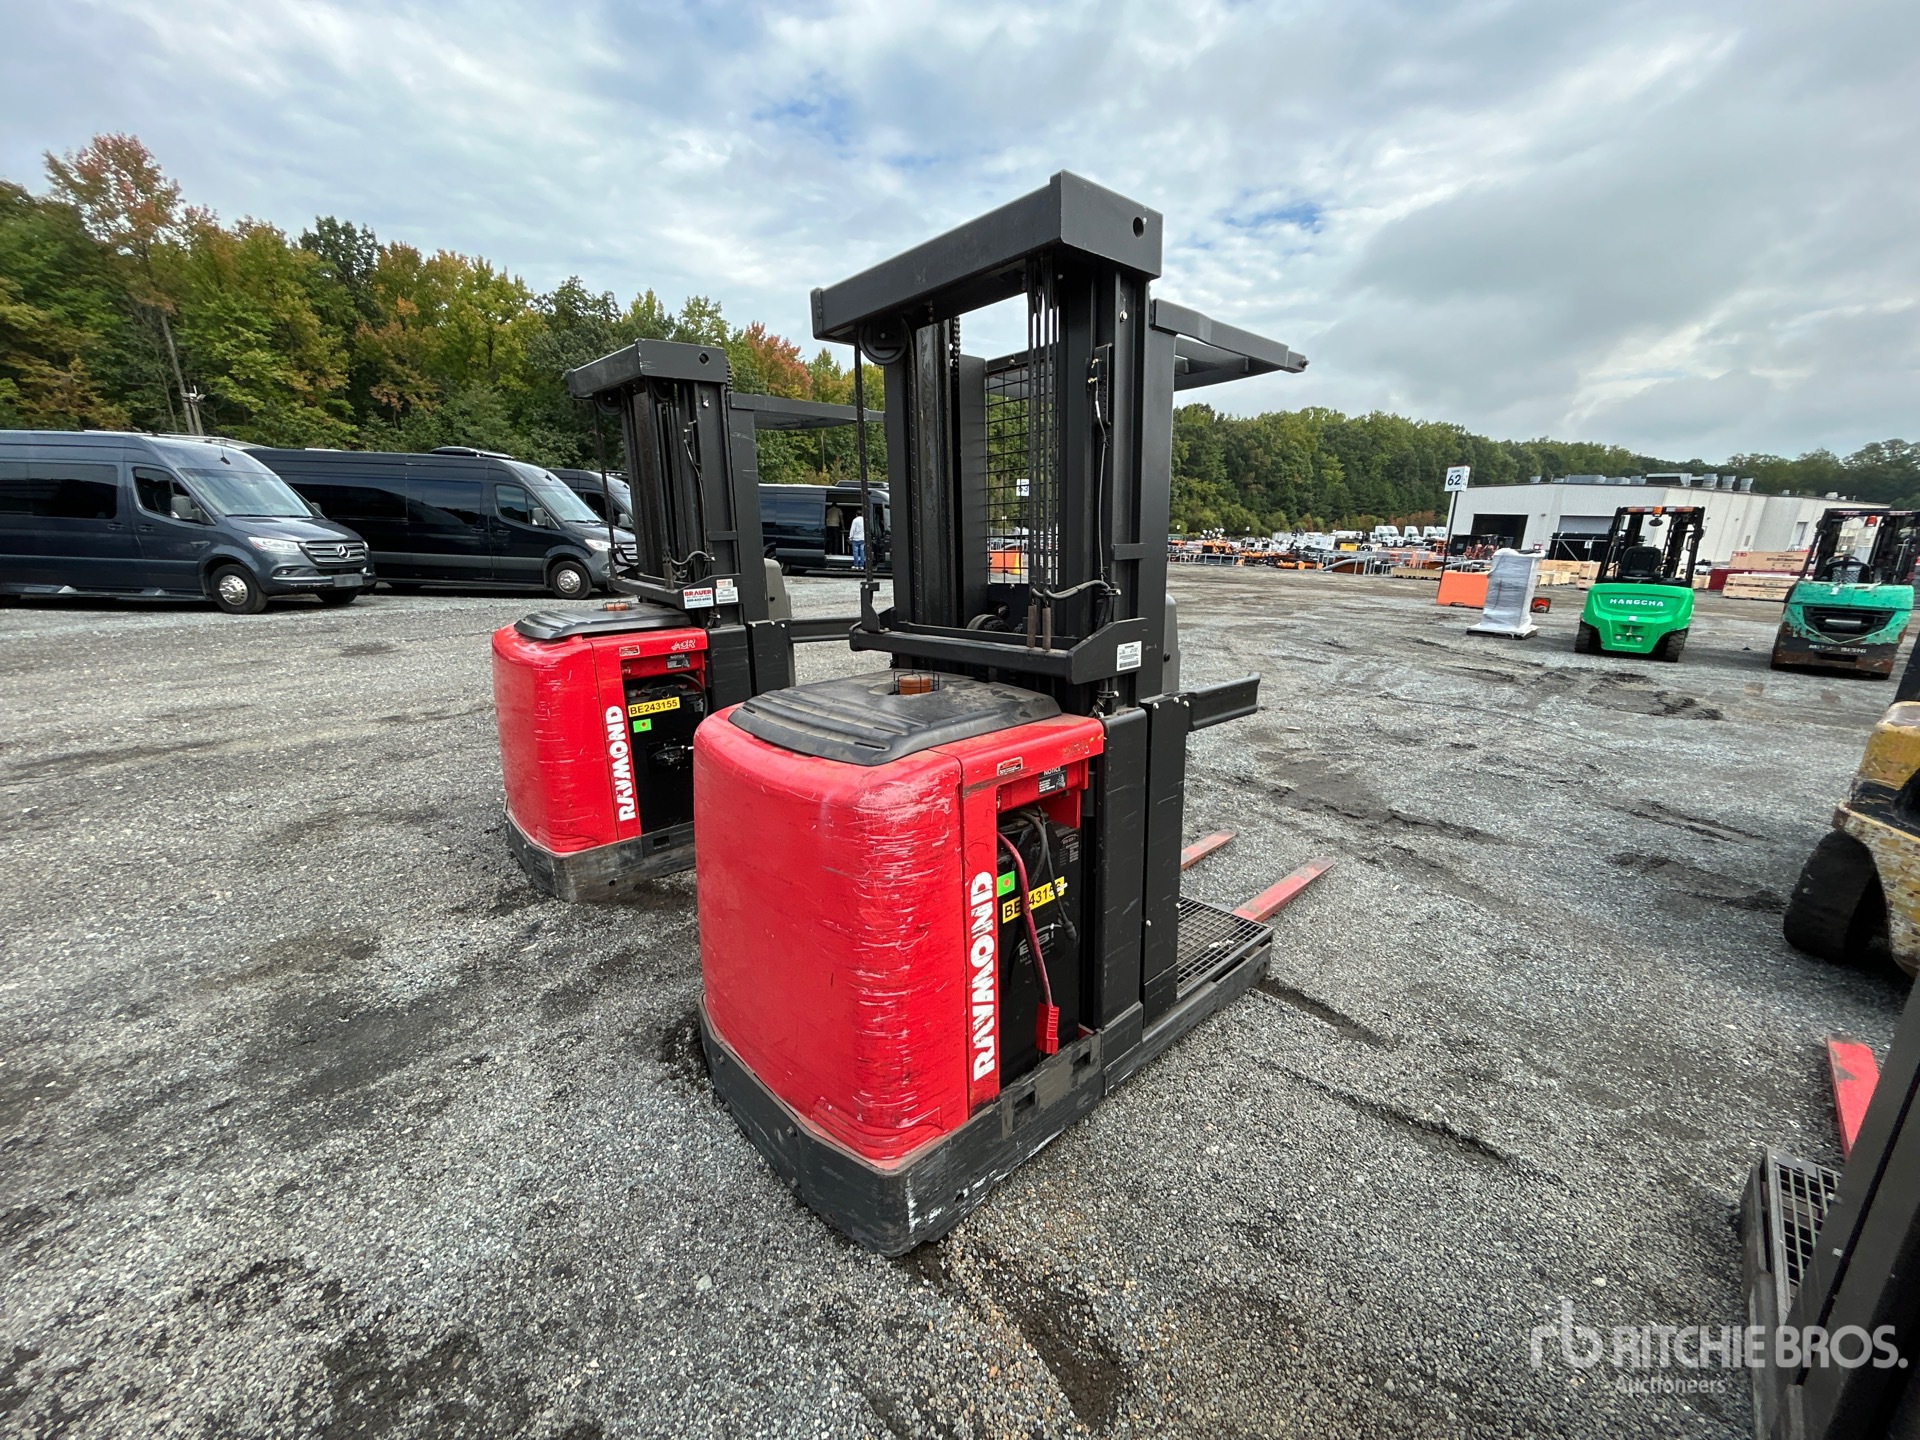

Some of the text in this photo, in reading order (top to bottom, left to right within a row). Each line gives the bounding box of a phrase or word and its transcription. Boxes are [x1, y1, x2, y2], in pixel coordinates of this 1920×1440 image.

[1447, 474, 1462, 486] 62
[1609, 598, 1664, 607] HANGCHA
[630, 701, 678, 715] BE243155
[605, 705, 637, 822] RAYMOND
[1004, 881, 1064, 918] BE4315
[970, 871, 995, 1081] RAYMOND
